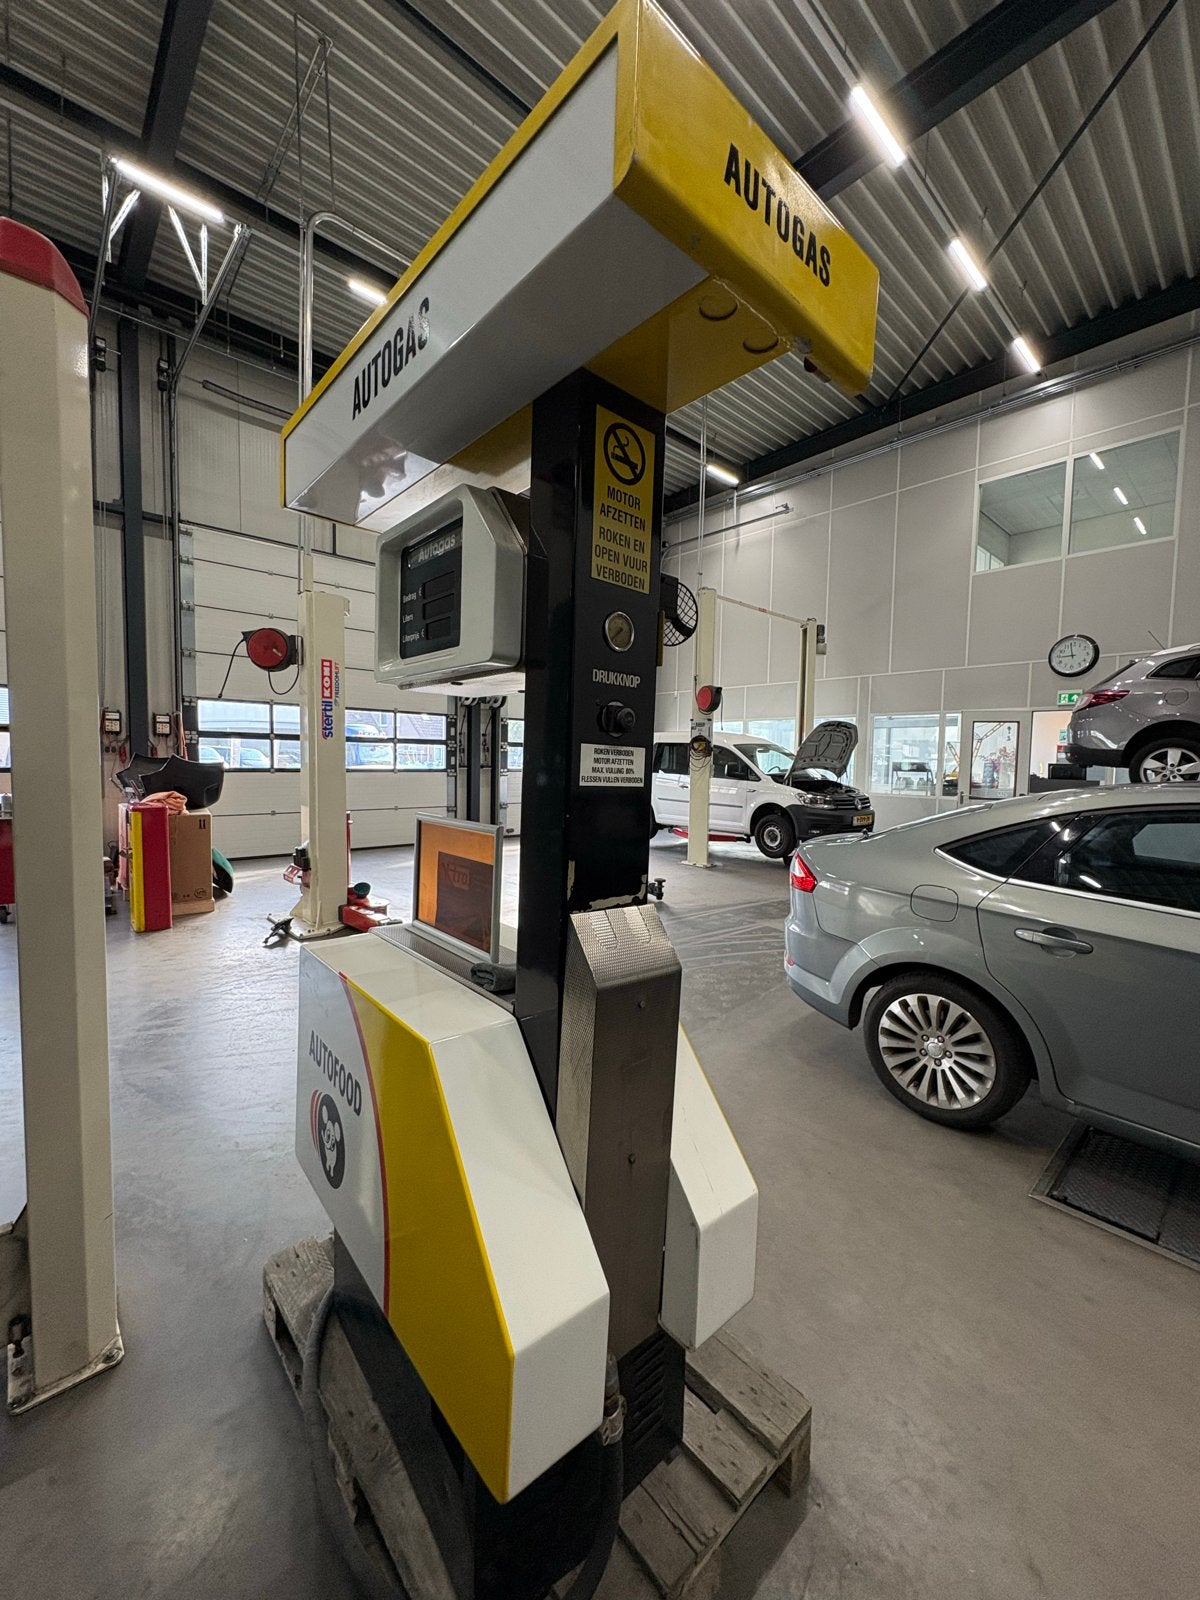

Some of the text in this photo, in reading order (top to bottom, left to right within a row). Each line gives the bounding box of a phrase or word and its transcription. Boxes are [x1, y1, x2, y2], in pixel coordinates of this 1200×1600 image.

[723, 142, 831, 287] AUTOGAS
[352, 297, 430, 421] AUTOGAS
[607, 485, 641, 511] MOTOR
[599, 503, 646, 531] AFZETTEN
[418, 534, 456, 563] Autogas
[599, 526, 645, 554] ROKEN EN
[594, 545, 648, 573] OPEN VUUR
[596, 564, 645, 591] VERBODEN
[592, 669, 641, 688] DRUKKNOP
[322, 700, 333, 739] stertil
[593, 757, 634, 766] MOTOR AFZETTEN
[610, 749, 634, 757] VERBODEN
[308, 1030, 363, 1117] AUTOFOOD
